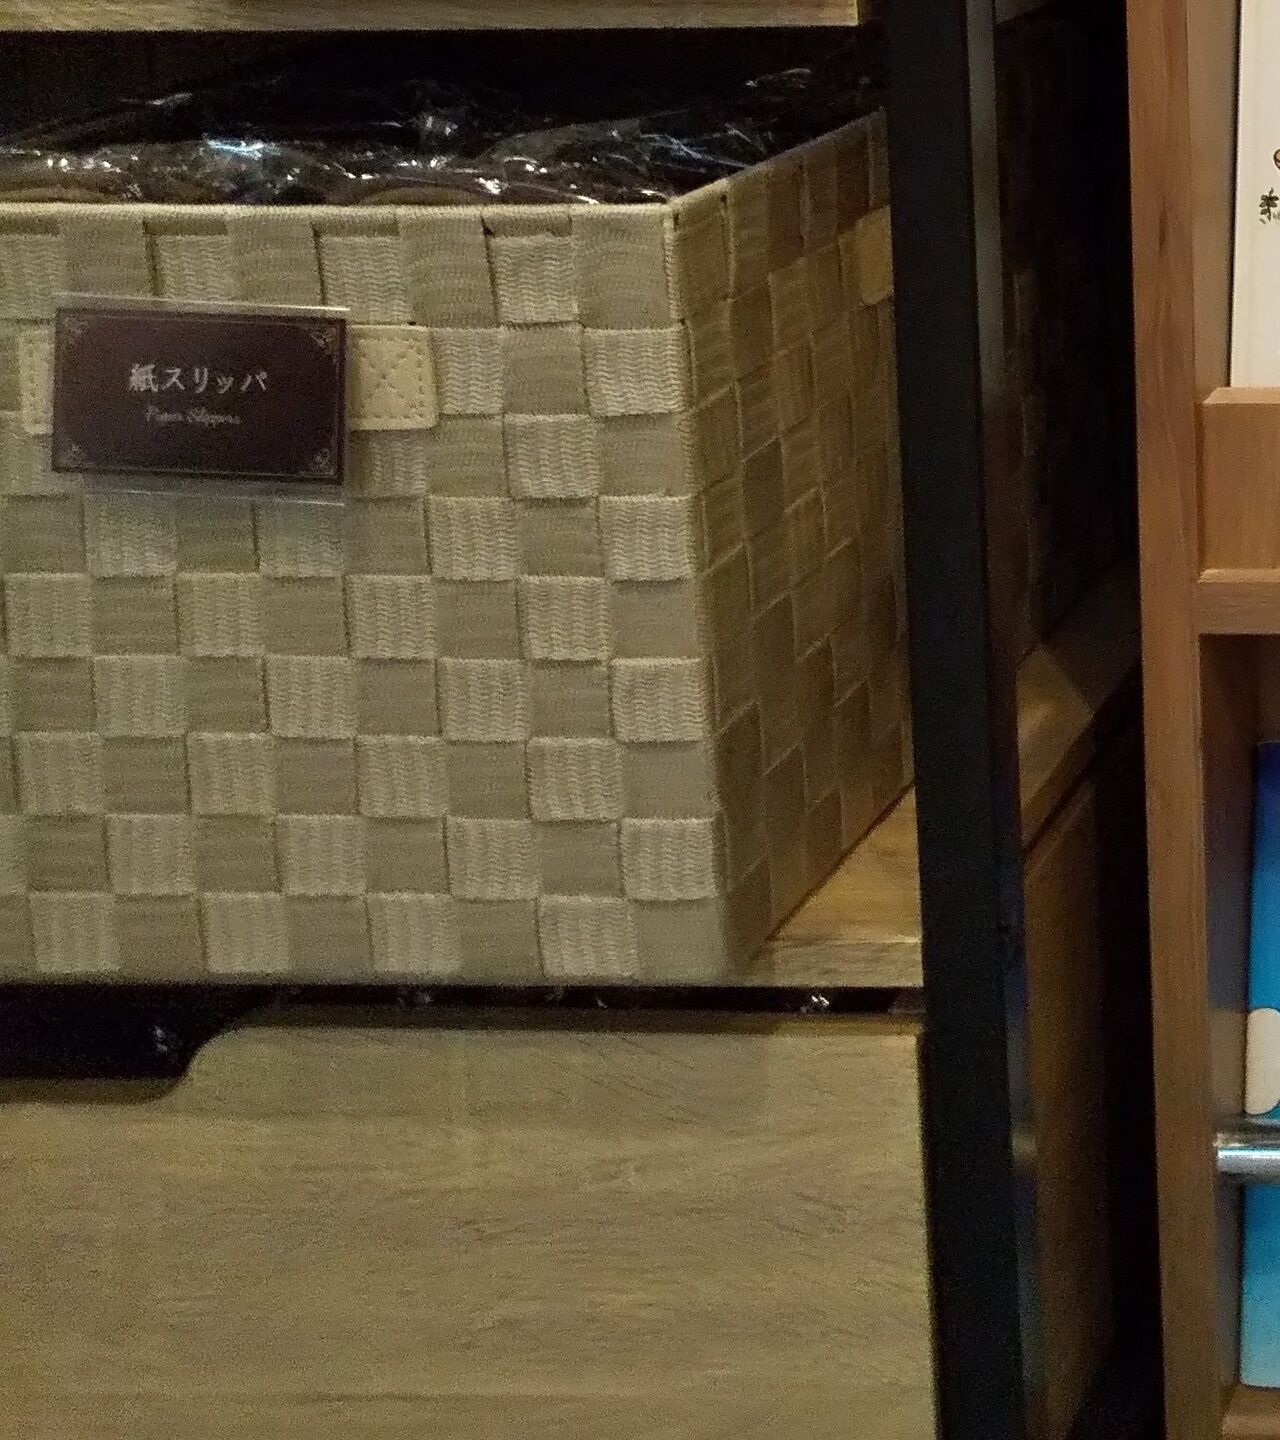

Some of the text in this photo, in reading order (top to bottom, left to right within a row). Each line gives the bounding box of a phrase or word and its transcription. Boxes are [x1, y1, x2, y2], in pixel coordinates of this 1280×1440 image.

[129, 363, 268, 394] 紙スリッパ
